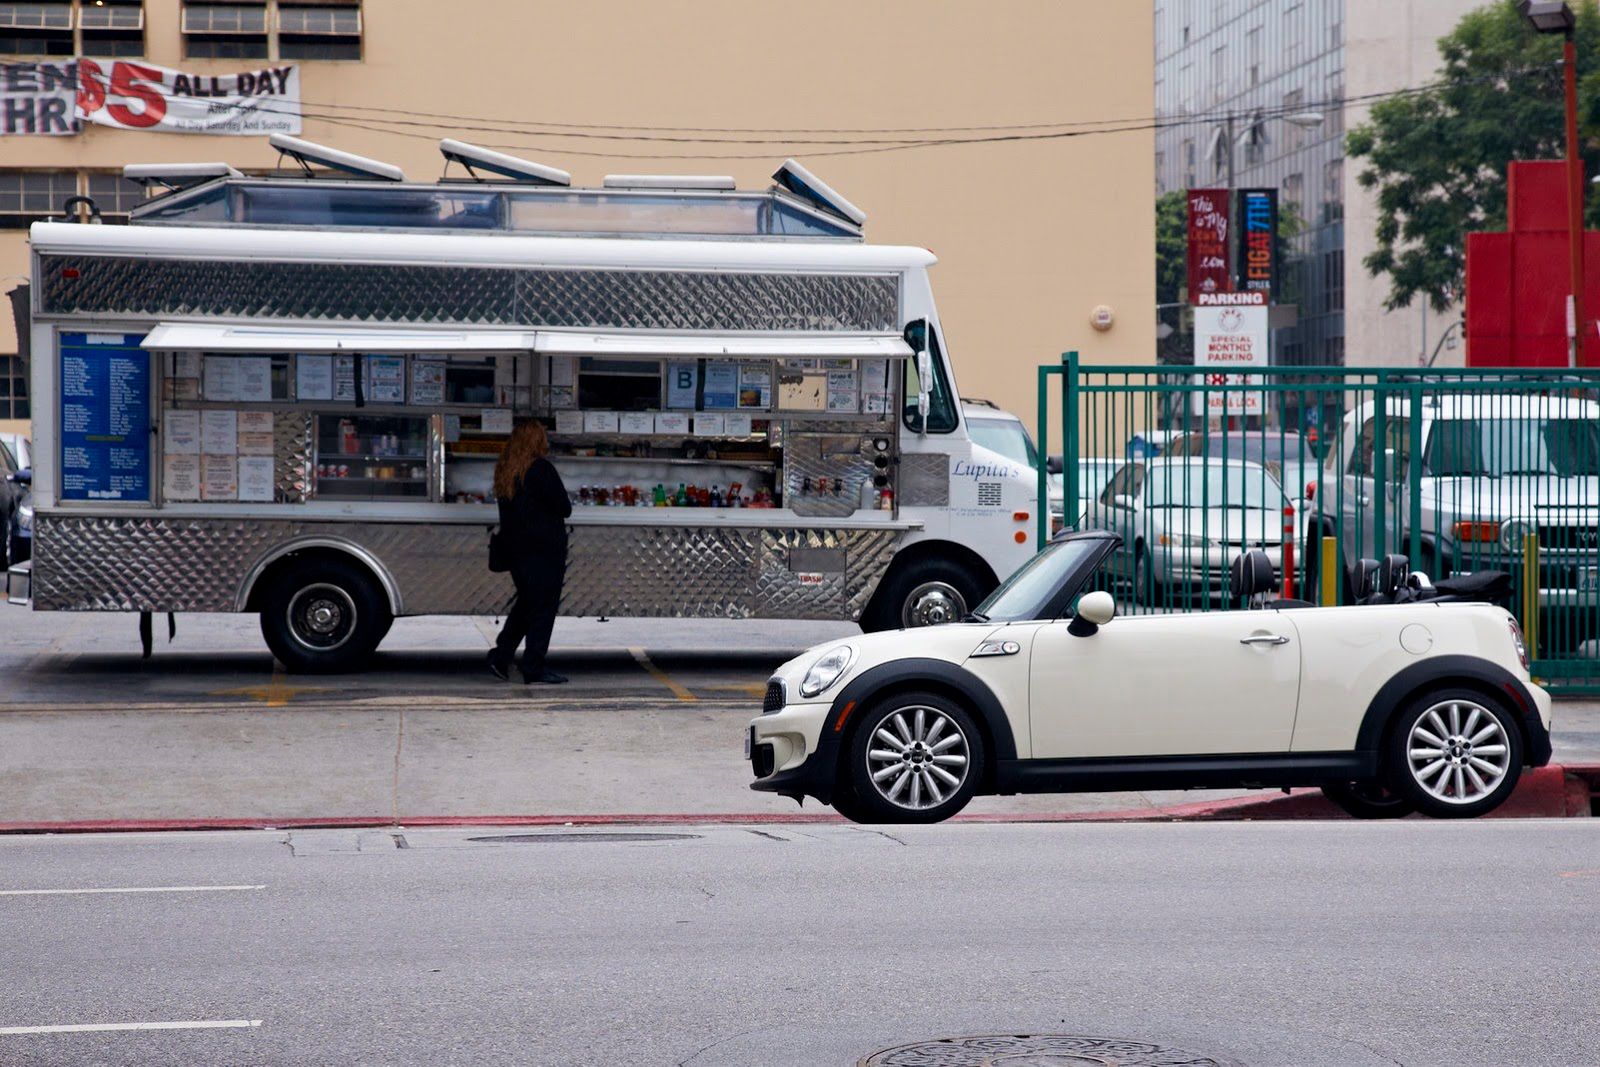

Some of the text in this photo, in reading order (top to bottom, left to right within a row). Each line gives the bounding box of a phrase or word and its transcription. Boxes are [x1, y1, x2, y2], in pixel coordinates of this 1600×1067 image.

[173, 74, 227, 97] ALL
[237, 66, 292, 96] DAY
[243, 120, 259, 130] And
[262, 119, 291, 131] Sunday
[1191, 196, 1213, 213] This
[1205, 212, 1228, 242] My
[1199, 292, 1263, 305] PARKING
[1210, 335, 1251, 343] SPECIAL
[1208, 343, 1253, 352] MONTHLY
[1207, 353, 1253, 361] PARKING
[677, 371, 693, 389] B
[799, 575, 823, 583] TRASH
